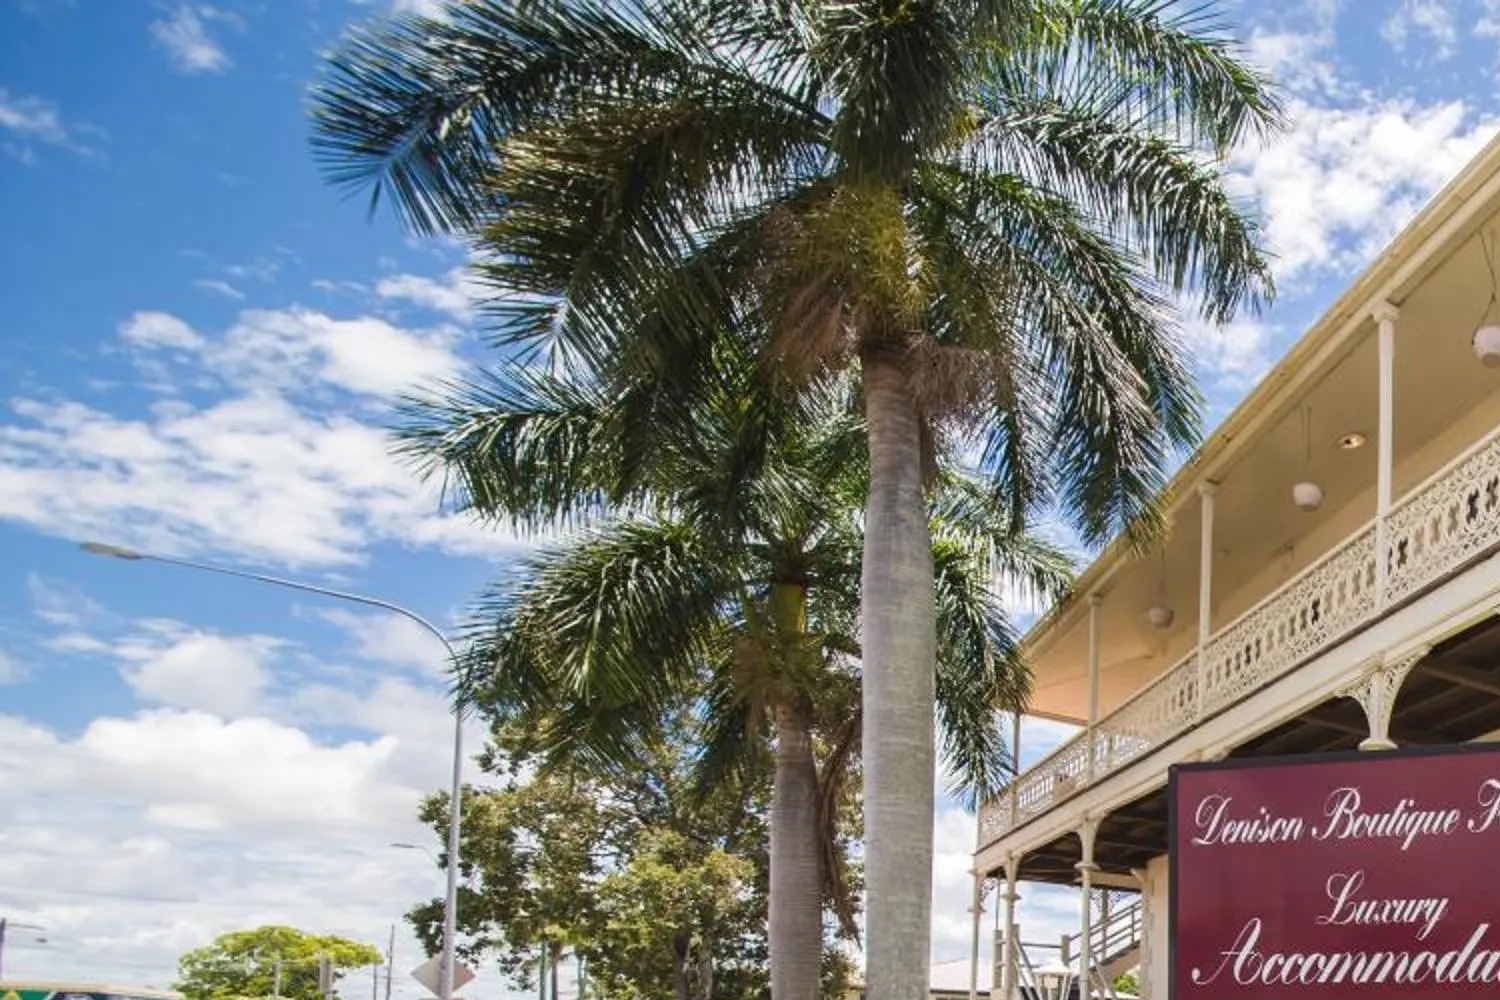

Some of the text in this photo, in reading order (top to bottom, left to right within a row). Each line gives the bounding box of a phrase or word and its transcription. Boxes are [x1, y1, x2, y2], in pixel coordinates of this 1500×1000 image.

[1192, 794, 1304, 845] Denison
[1311, 786, 1461, 851] Boutique
[1315, 870, 1449, 941] Luxury
